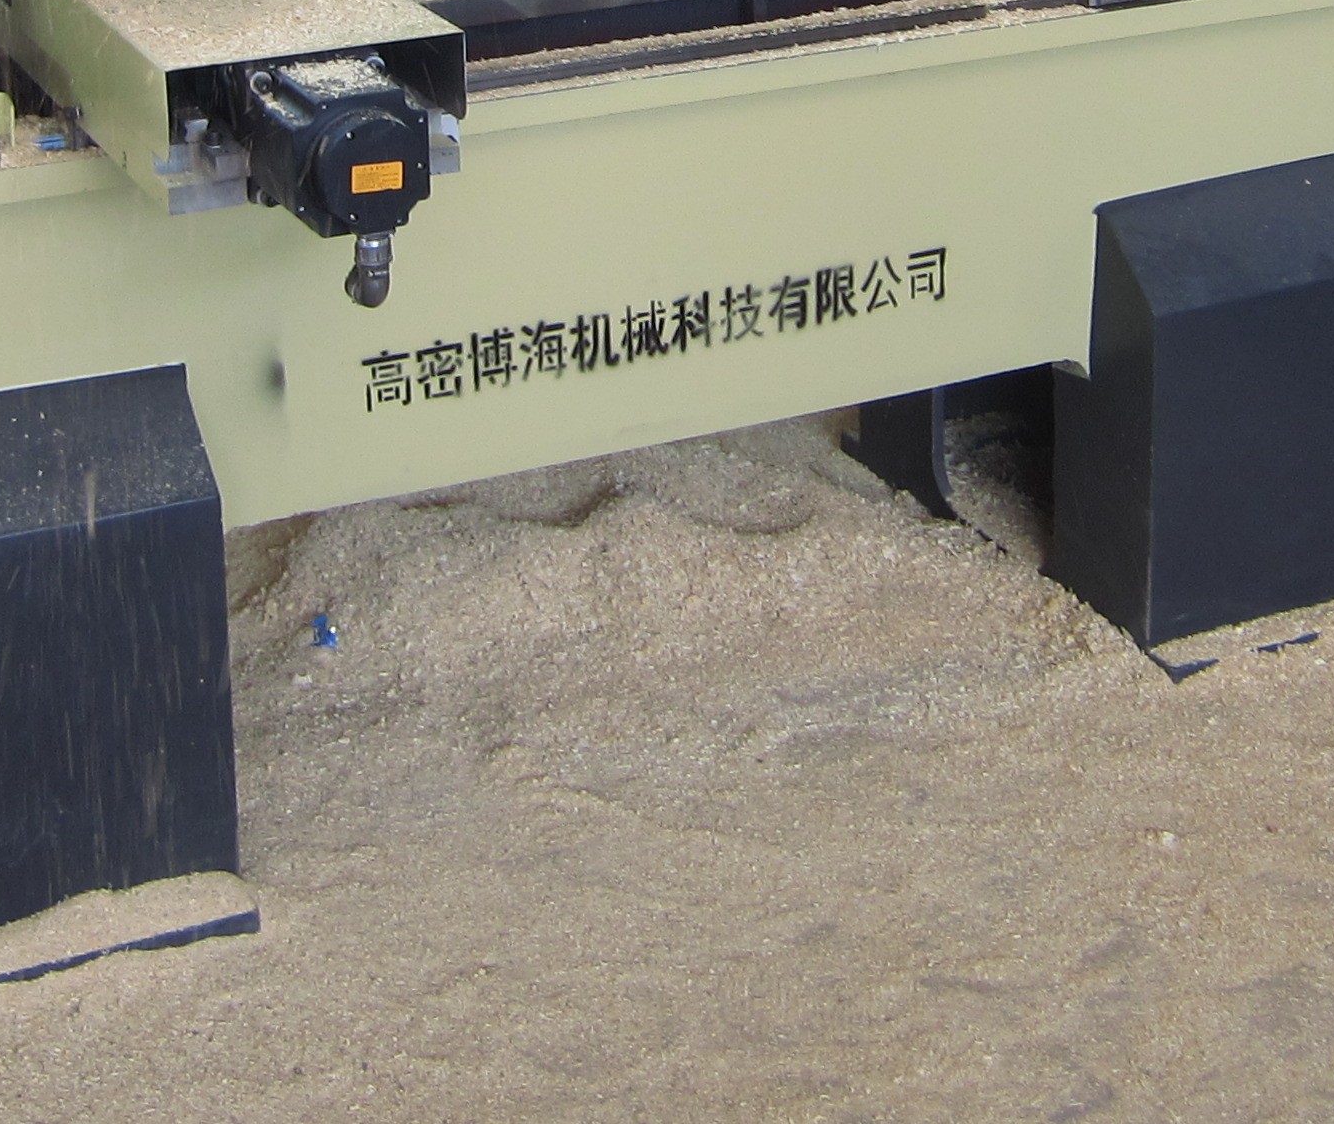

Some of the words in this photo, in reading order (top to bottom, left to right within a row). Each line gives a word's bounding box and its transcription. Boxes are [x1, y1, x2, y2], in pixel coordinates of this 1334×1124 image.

[361, 246, 948, 413] 高密博海机械科技有限公司
